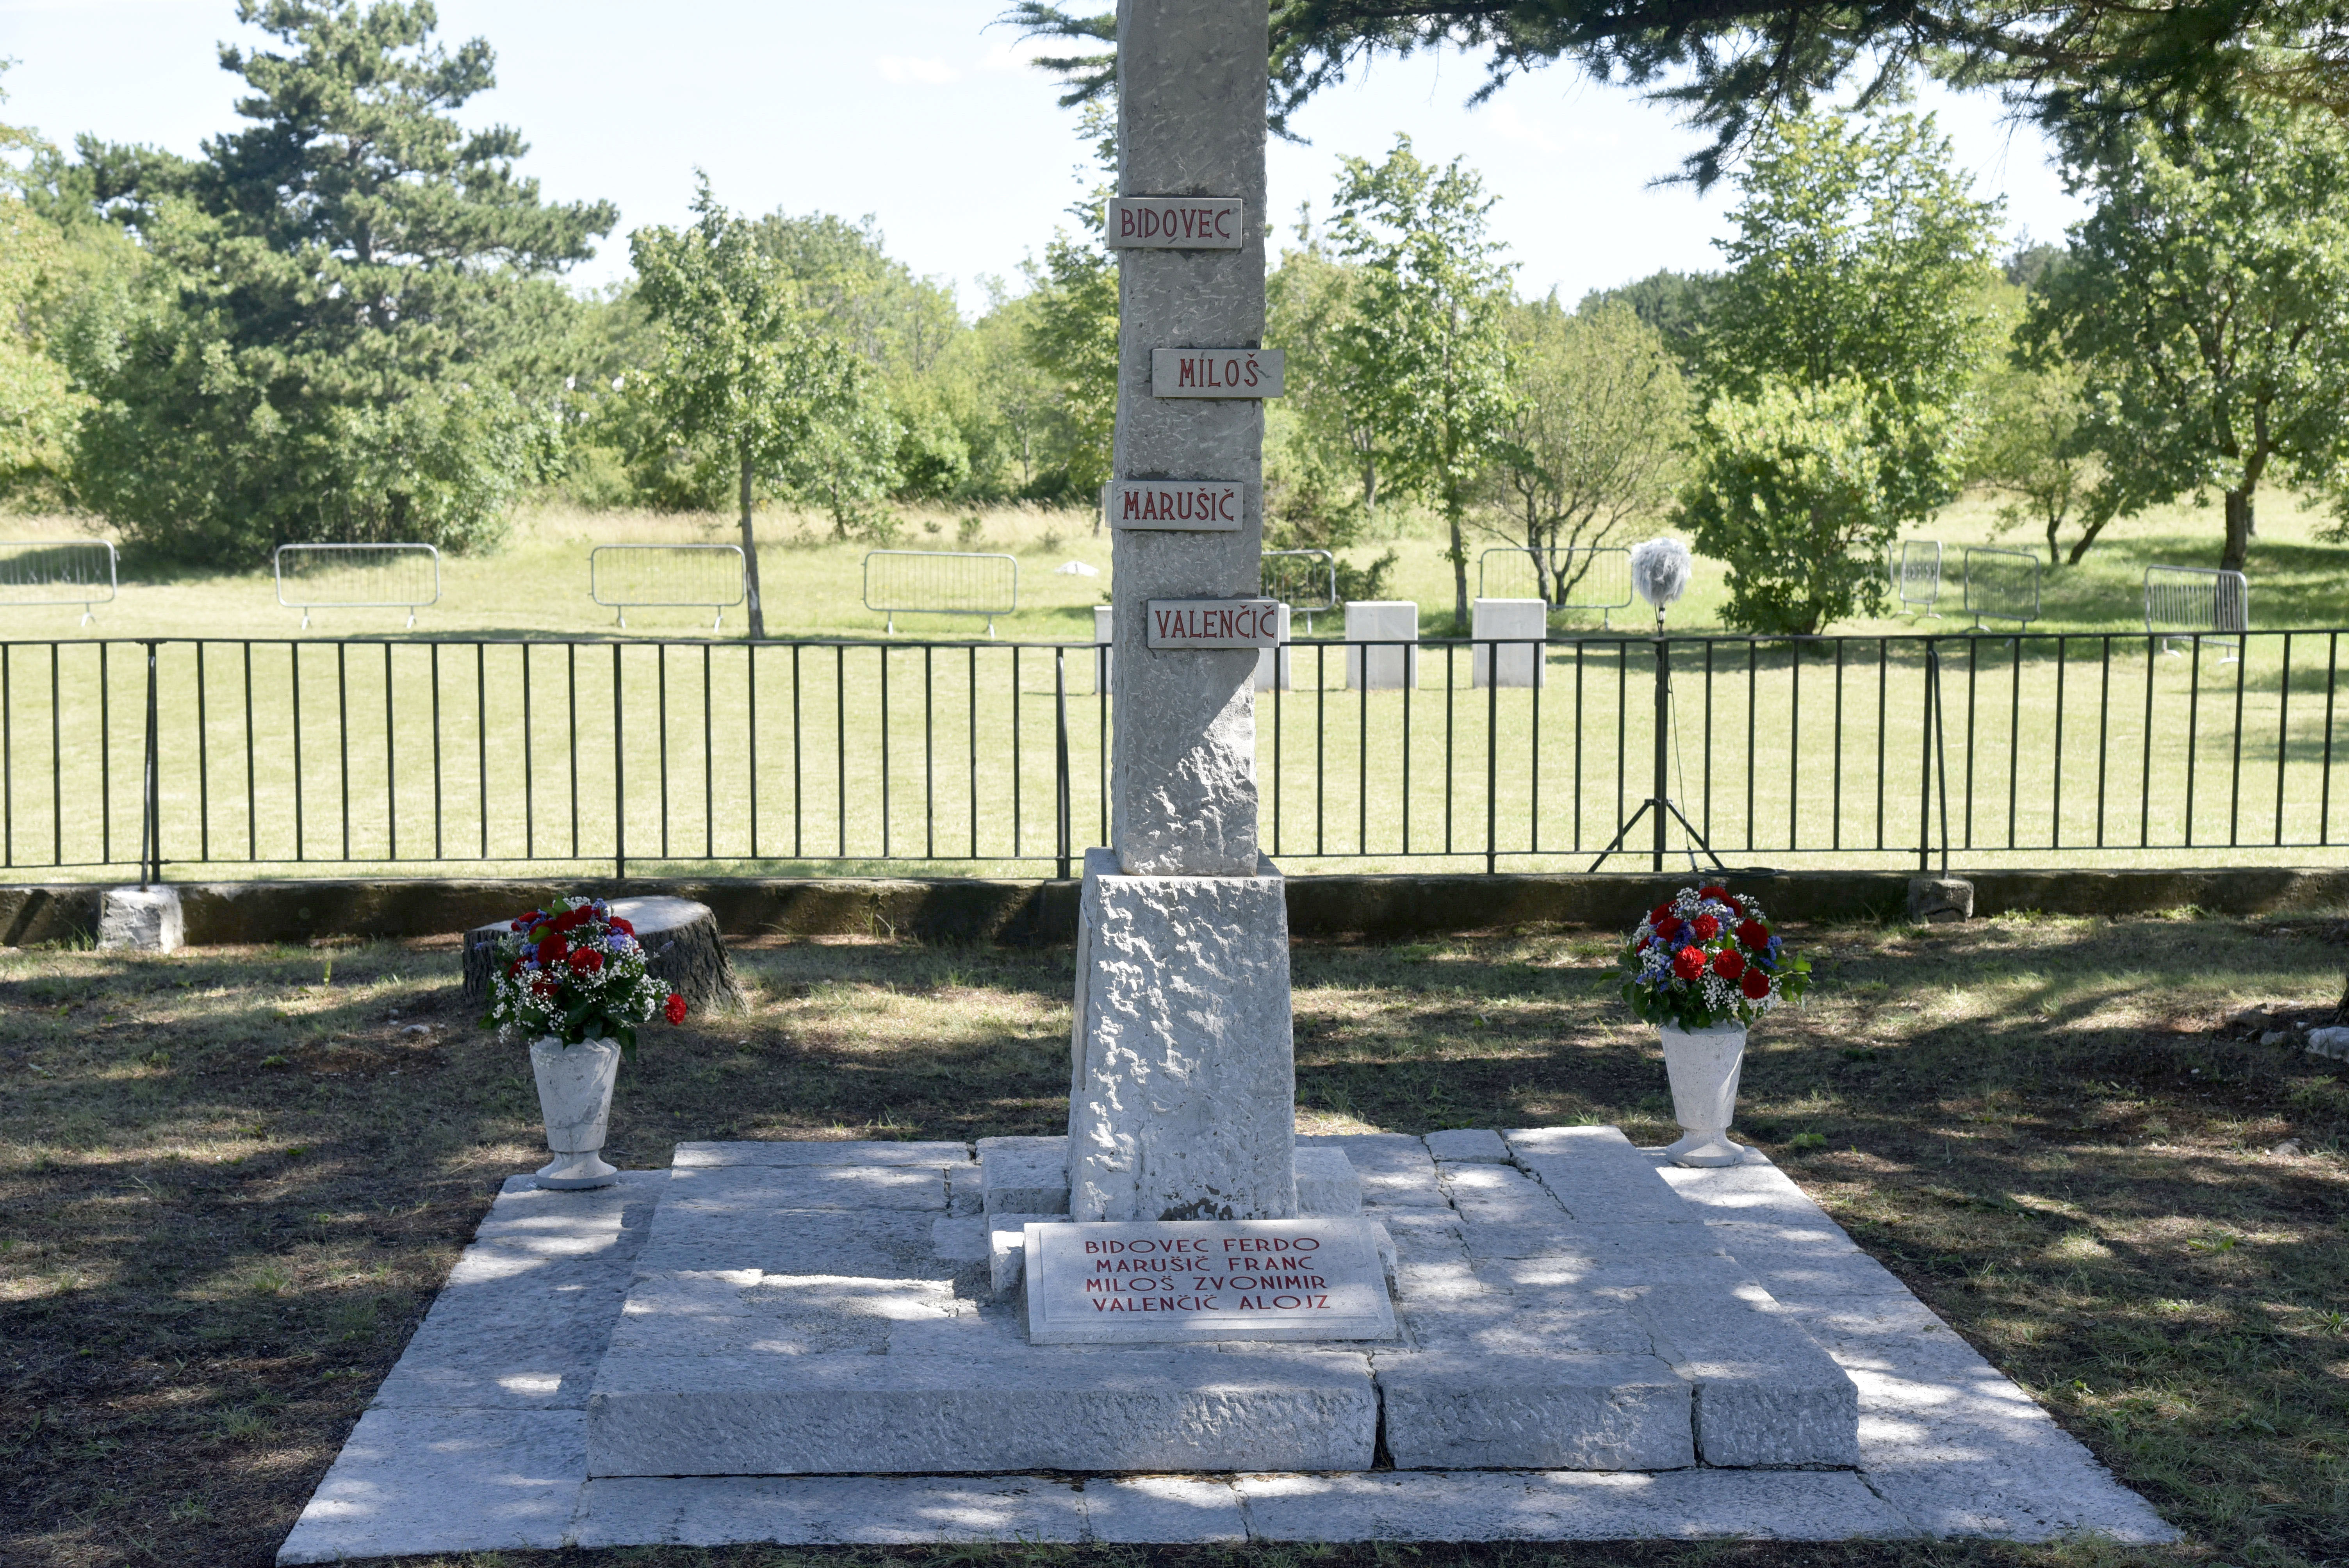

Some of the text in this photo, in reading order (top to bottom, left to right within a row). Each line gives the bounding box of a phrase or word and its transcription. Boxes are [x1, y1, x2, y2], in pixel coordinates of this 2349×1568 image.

[1121, 208, 1230, 239] BIDOVEC
[1178, 353, 1259, 387] MILOŠ
[1123, 487, 1234, 521] MARUŠIČ
[1155, 605, 1274, 639] VALENČIČ
[1085, 1237, 1319, 1254] BIDOVEC FERDO
[1096, 1256, 1314, 1272] MARUŠIČ FRANC
[1086, 1275, 1328, 1292] MILOŠ ZVONIMIR
[1092, 1294, 1330, 1312] VALENČIČ ALOJZ
